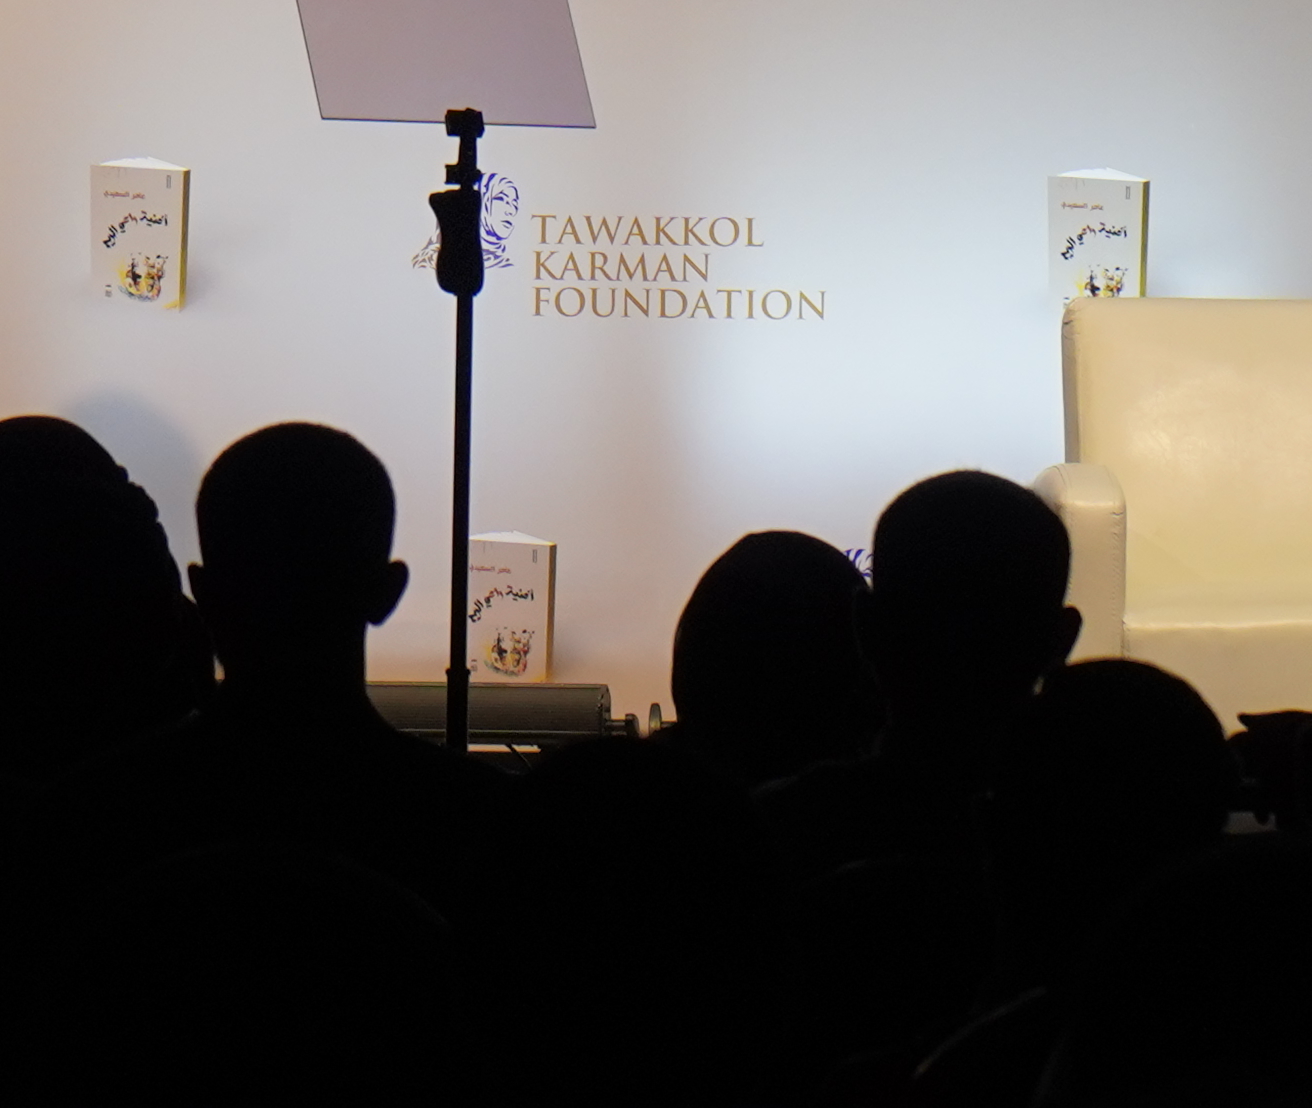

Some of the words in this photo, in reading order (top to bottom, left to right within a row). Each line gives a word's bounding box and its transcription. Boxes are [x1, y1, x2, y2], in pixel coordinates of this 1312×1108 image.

[531, 214, 764, 248] TAWAKKOL
[534, 250, 710, 283] KARMAN
[533, 286, 826, 321] FOUNDATION
